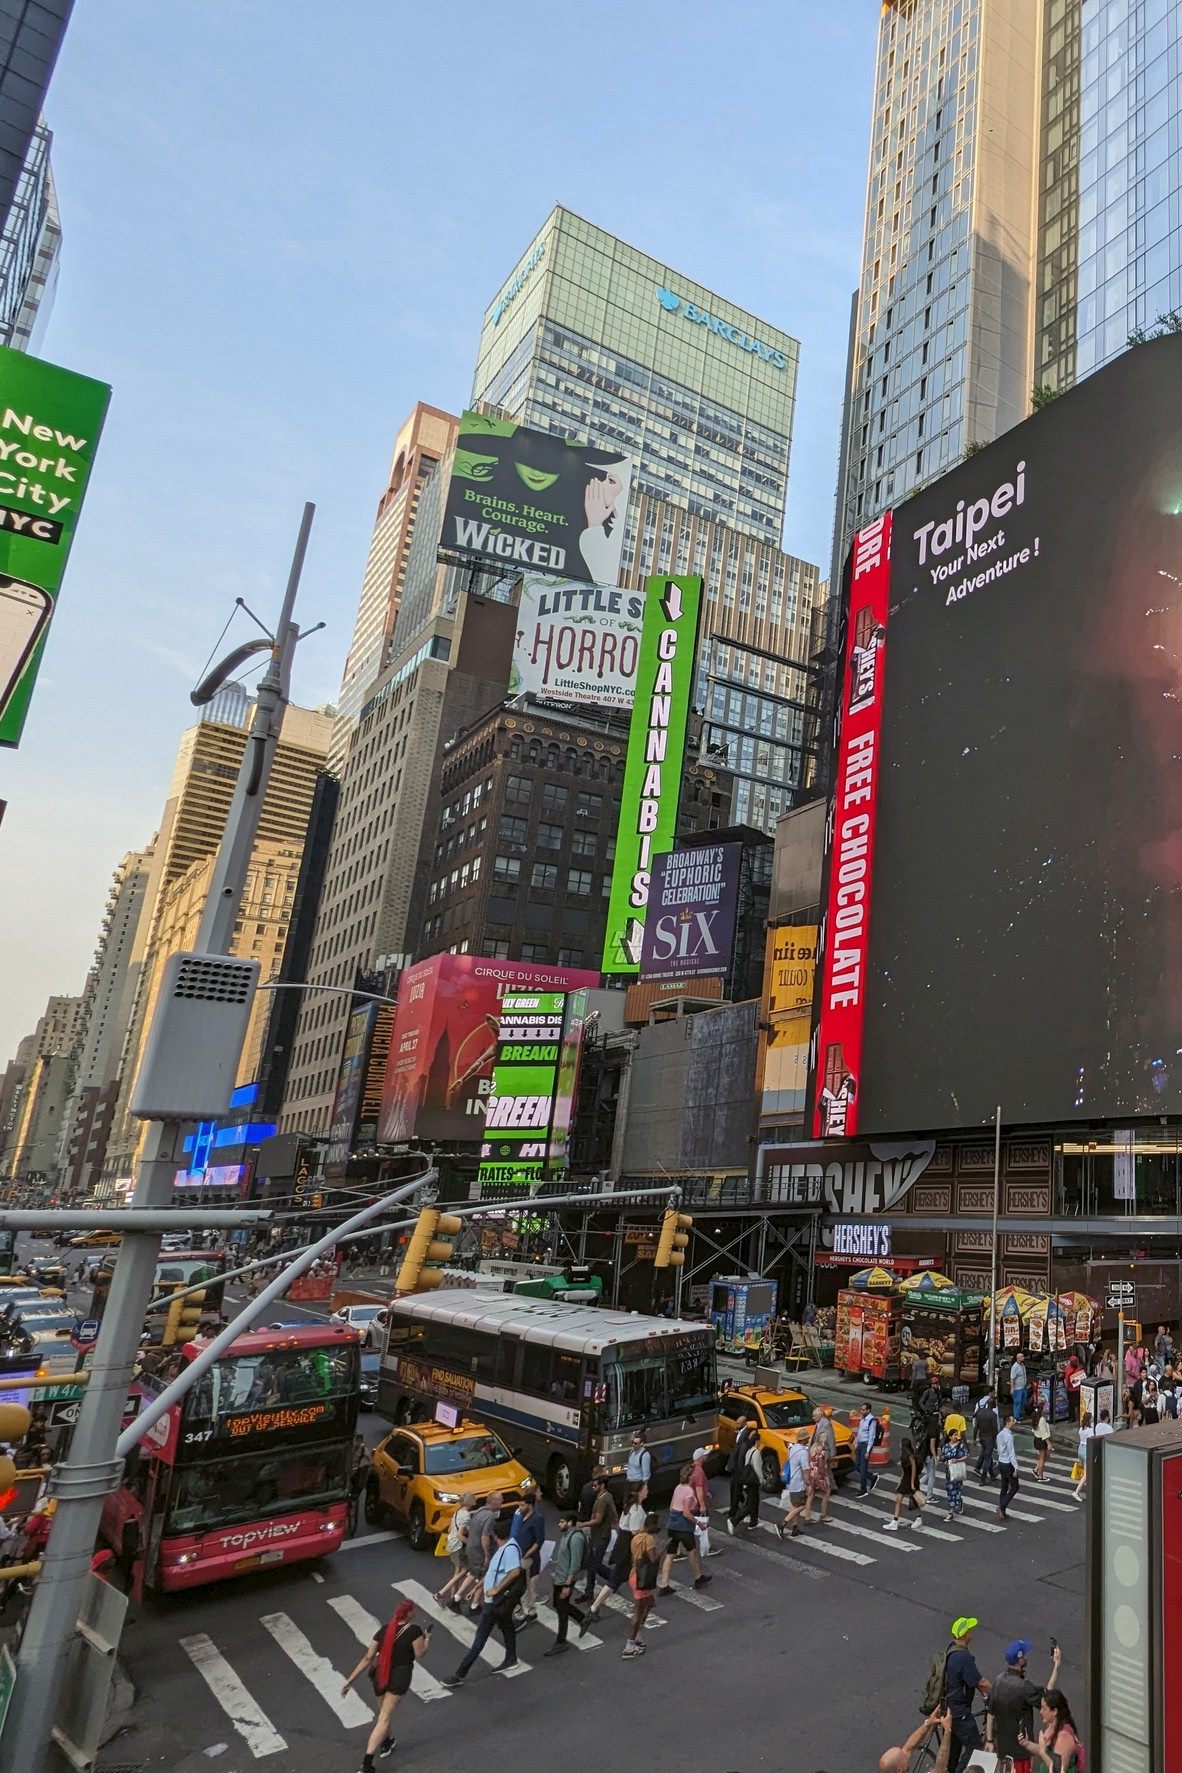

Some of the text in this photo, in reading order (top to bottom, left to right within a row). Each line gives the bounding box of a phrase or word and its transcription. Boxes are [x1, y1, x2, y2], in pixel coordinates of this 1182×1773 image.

[683, 302, 787, 370] BARCLAYS
[2, 408, 87, 451] New
[0, 438, 77, 482] York
[0, 471, 71, 514] City
[464, 489, 568, 526] Brains. Heart.
[482, 507, 549, 533] Courage.
[913, 460, 1026, 565] Taipei
[930, 529, 1005, 585] Your Next
[945, 547, 1030, 606] Adventure
[537, 589, 623, 617] LITTLE
[599, 617, 616, 628] OF
[530, 622, 639, 685] HORRO
[540, 687, 574, 699] Westside
[574, 692, 601, 702] Theatre
[603, 695, 616, 703] 407
[630, 628, 678, 908] CANNABIS
[666, 847, 724, 870] BROADWAY'S
[829, 729, 875, 1011] FREE CHOCOLATE
[475, 967, 568, 985] CIRQUE DU SOLEIL
[834, 1224, 890, 1256] HERSHEY'S
[852, 1256, 878, 1265] CHOCOLATE
[878, 1258, 895, 1266] WORLD
[48, 1384, 60, 1398] W
[184, 1430, 213, 1444] 347
